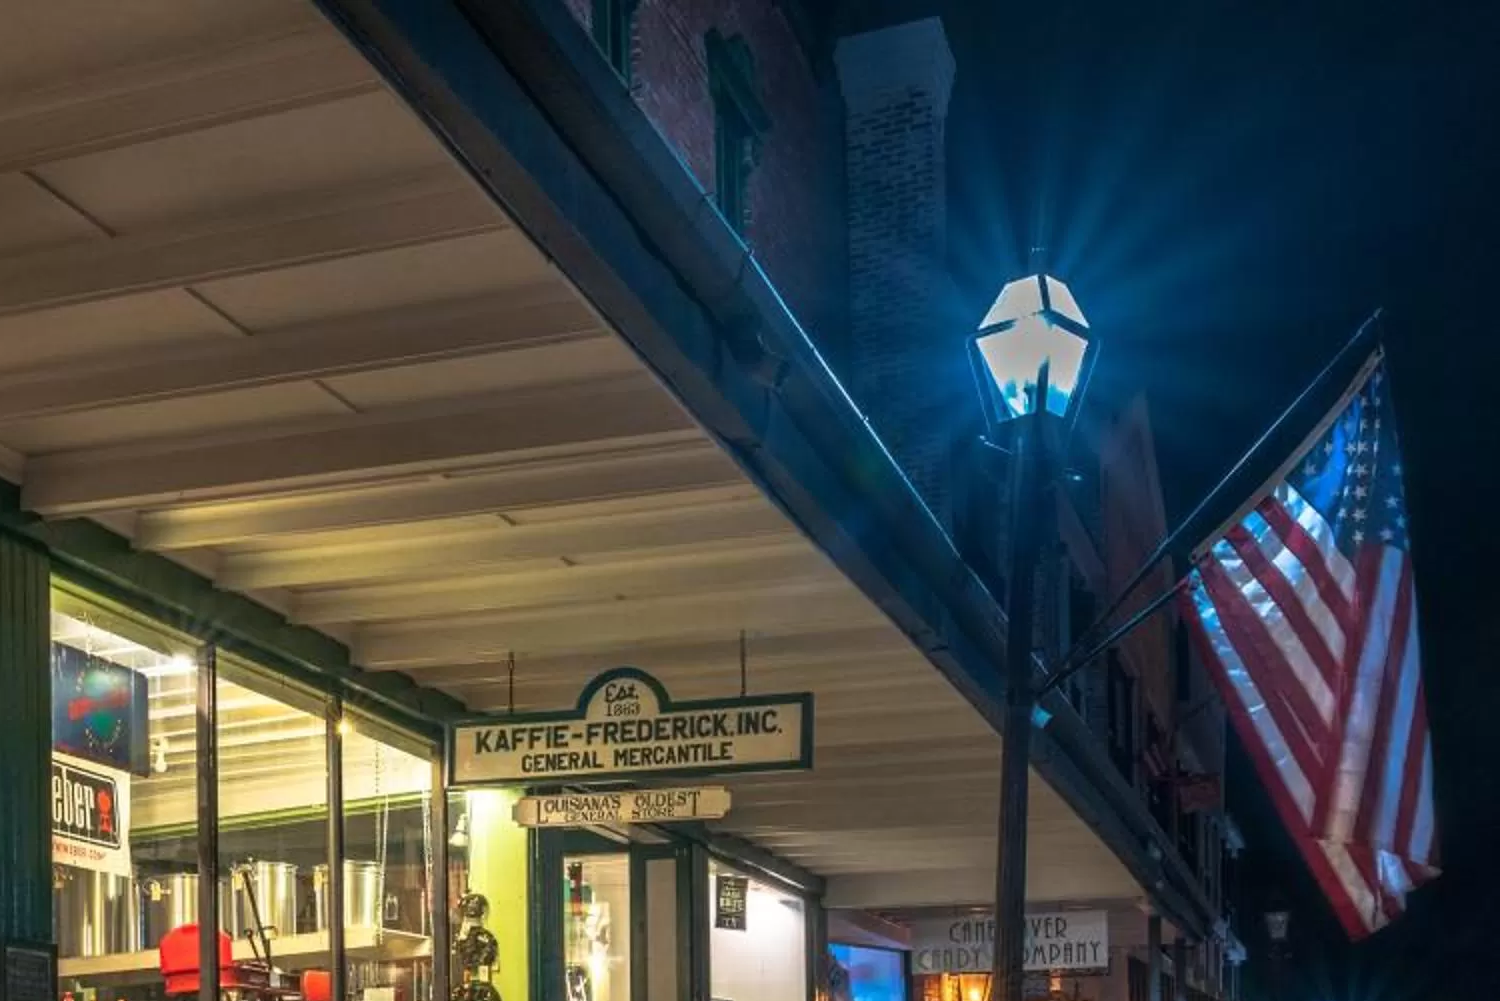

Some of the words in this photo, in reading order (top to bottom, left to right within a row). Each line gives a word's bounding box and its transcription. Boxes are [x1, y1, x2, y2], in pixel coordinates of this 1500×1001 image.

[521, 751, 605, 773] GENERAL
[613, 741, 733, 767] MERCANTILE
[52, 766, 96, 831] eber
[633, 790, 700, 817] OLDEST
[564, 810, 621, 823] GENERAL
[631, 806, 675, 820] STORE
[917, 947, 981, 970] CANDY
[1022, 941, 1101, 964] OMPANY
